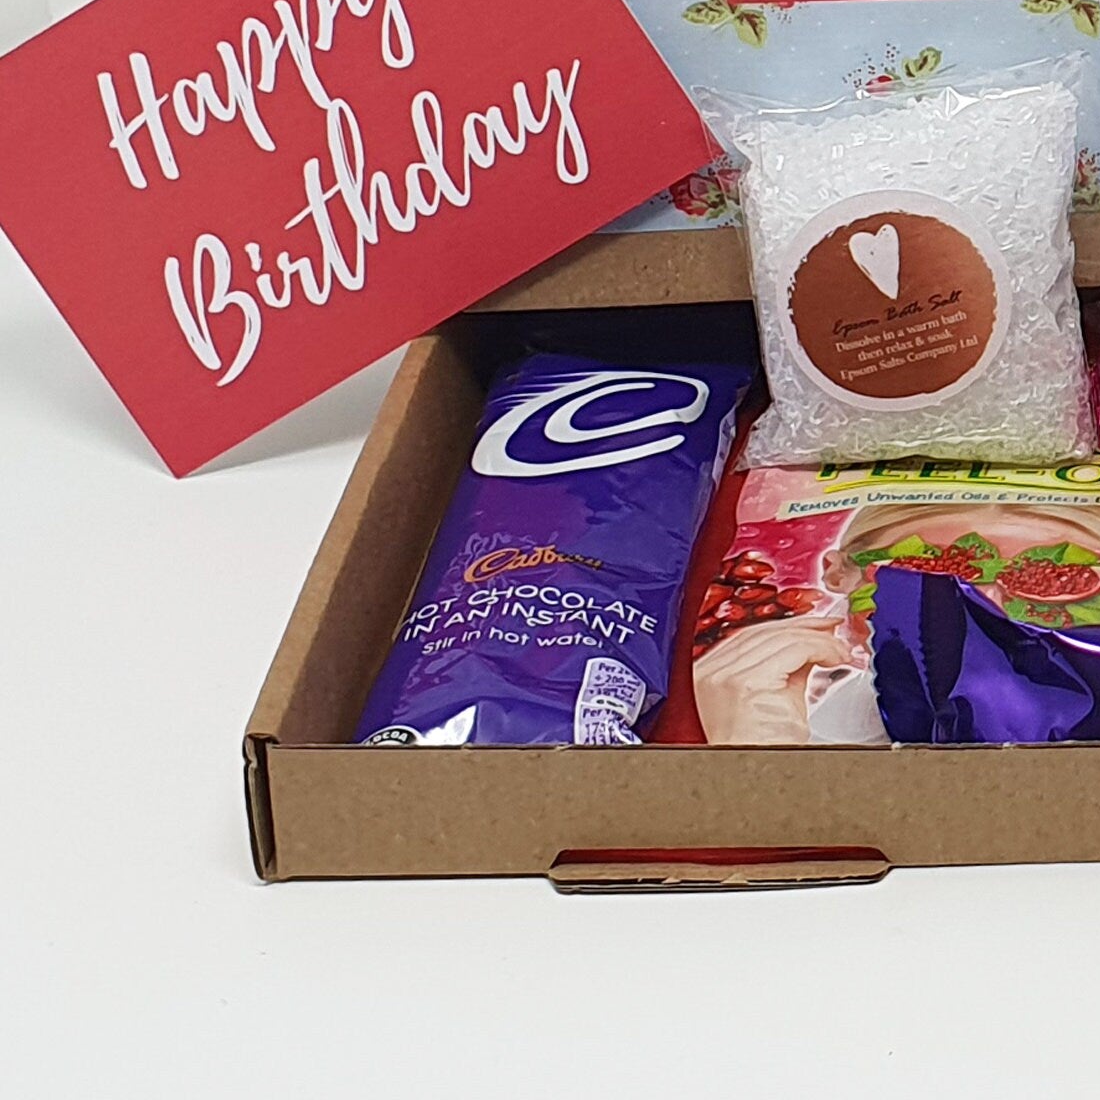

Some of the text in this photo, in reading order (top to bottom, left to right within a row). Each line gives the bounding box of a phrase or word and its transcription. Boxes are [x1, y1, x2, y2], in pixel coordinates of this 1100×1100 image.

[164, 59, 589, 387] Birthday
[906, 319, 940, 334] warm
[857, 348, 885, 363] then
[885, 340, 914, 355] relax
[906, 343, 959, 363] Company
[867, 491, 954, 502] Unwanted
[467, 585, 658, 635] CHOCOLATE
[403, 601, 635, 645] IN AN INSTANT
[489, 626, 530, 647] hot
